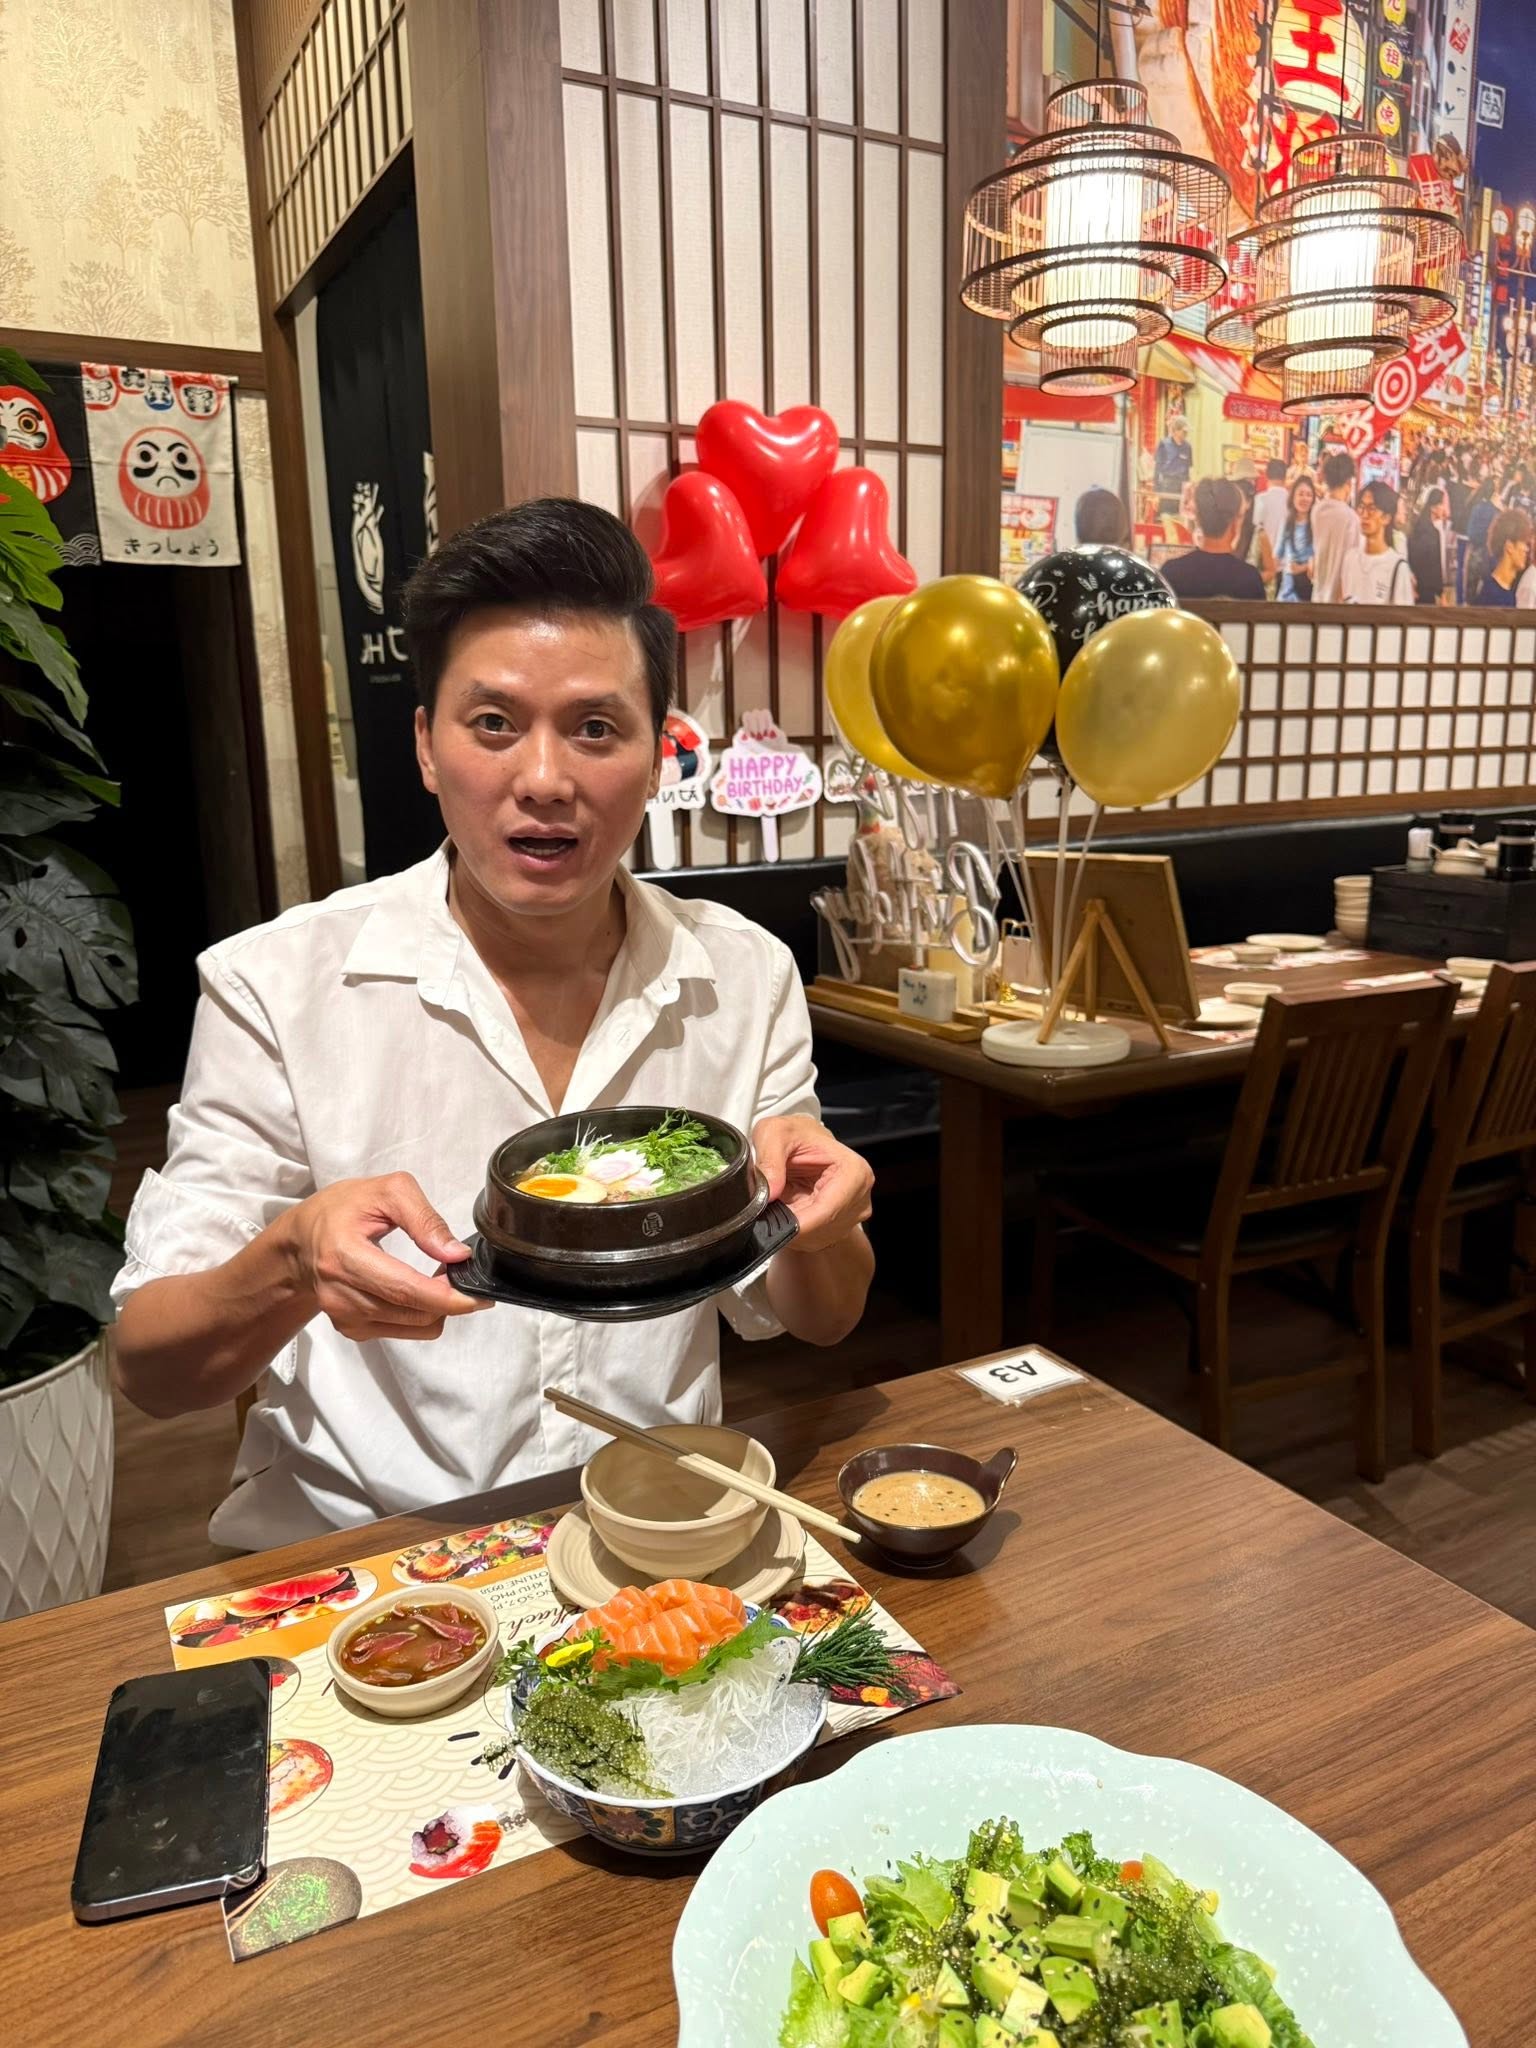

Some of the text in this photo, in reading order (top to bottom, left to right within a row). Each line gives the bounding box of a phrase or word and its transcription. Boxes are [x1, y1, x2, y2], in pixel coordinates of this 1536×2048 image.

[124, 537, 220, 557] きっしょう
[729, 755, 798, 780] HAPPY
[727, 776, 803, 799] BIRTHDAY
[988, 1360, 1038, 1383] A3
[519, 1582, 544, 1594] KHU
